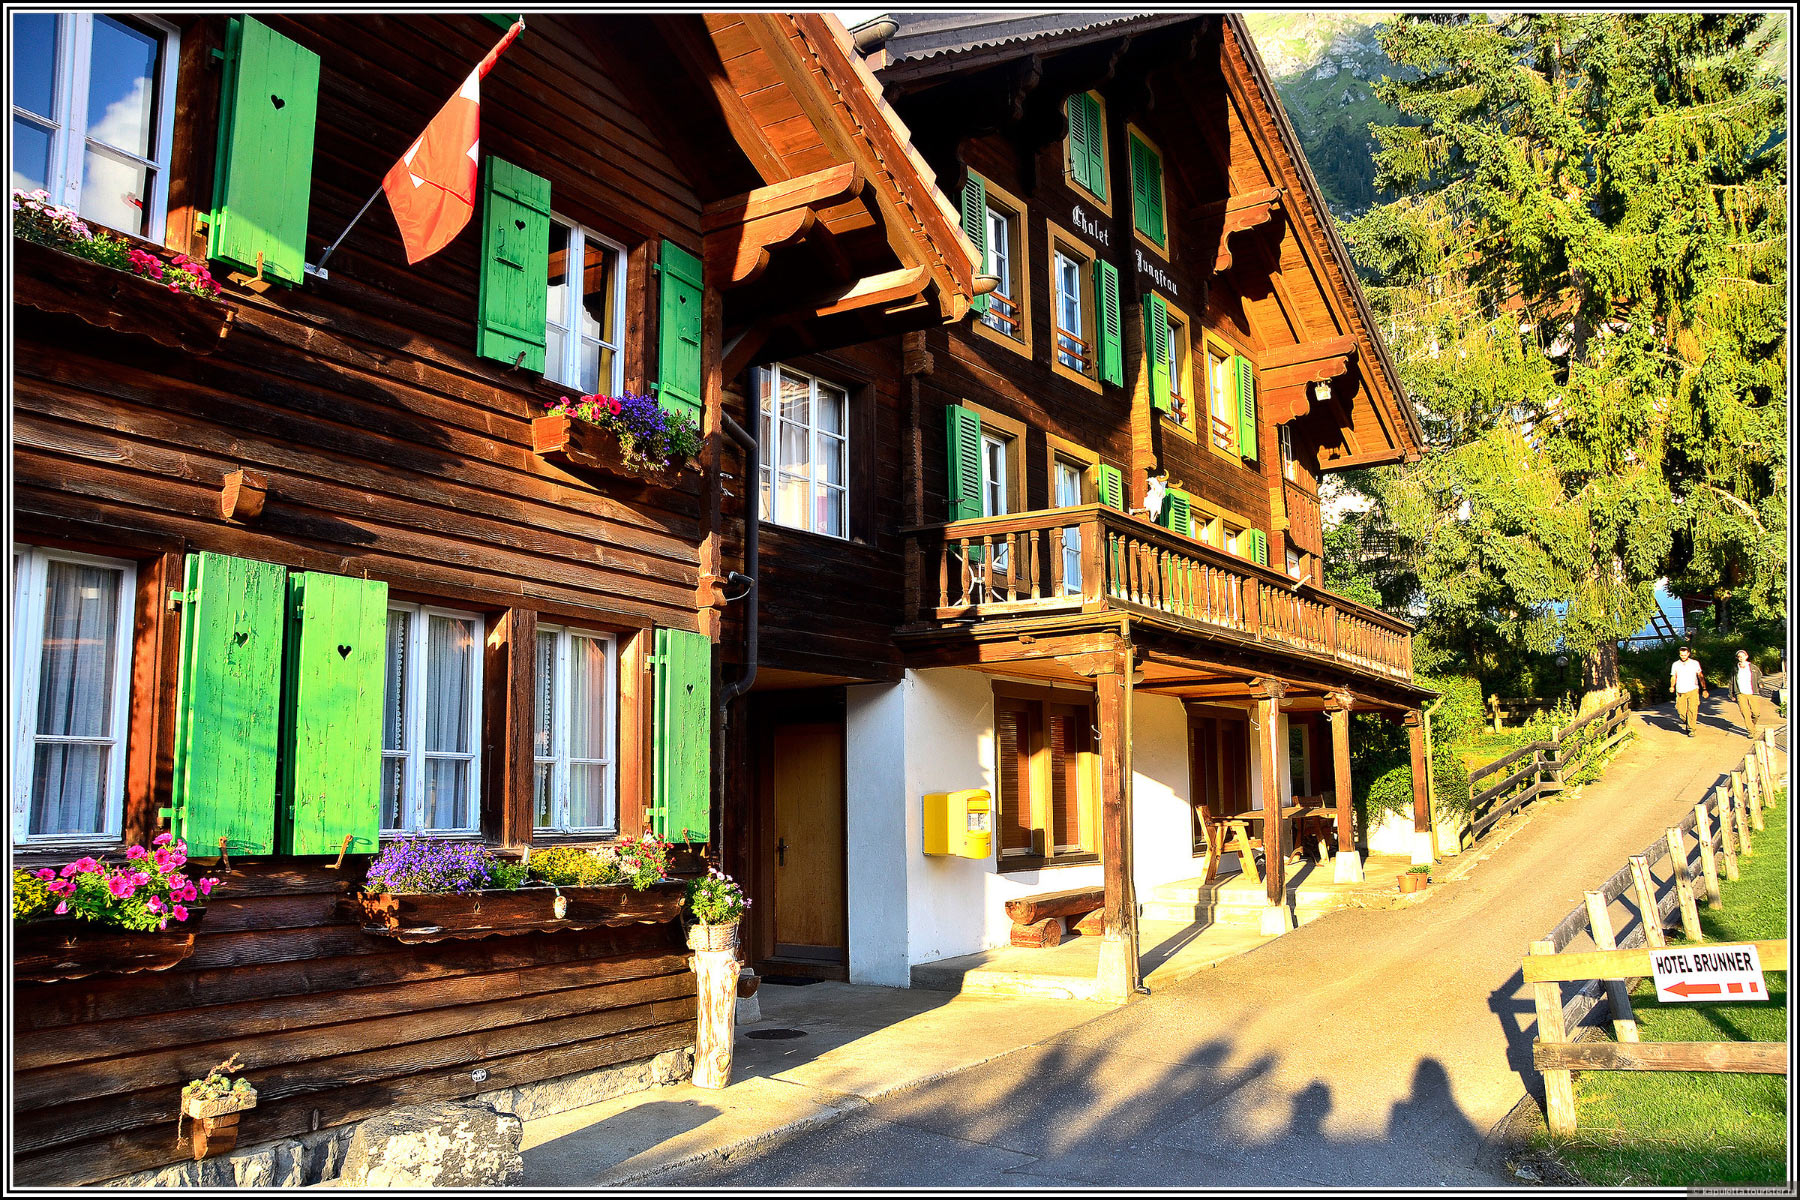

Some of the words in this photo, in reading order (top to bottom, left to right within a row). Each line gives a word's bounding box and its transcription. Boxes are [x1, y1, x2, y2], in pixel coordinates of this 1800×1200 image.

[1072, 204, 1109, 247] Chalet
[1135, 248, 1178, 296] Jungfrau
[1655, 954, 1693, 975] HOTEL
[1693, 952, 1754, 973] BRUNNER
